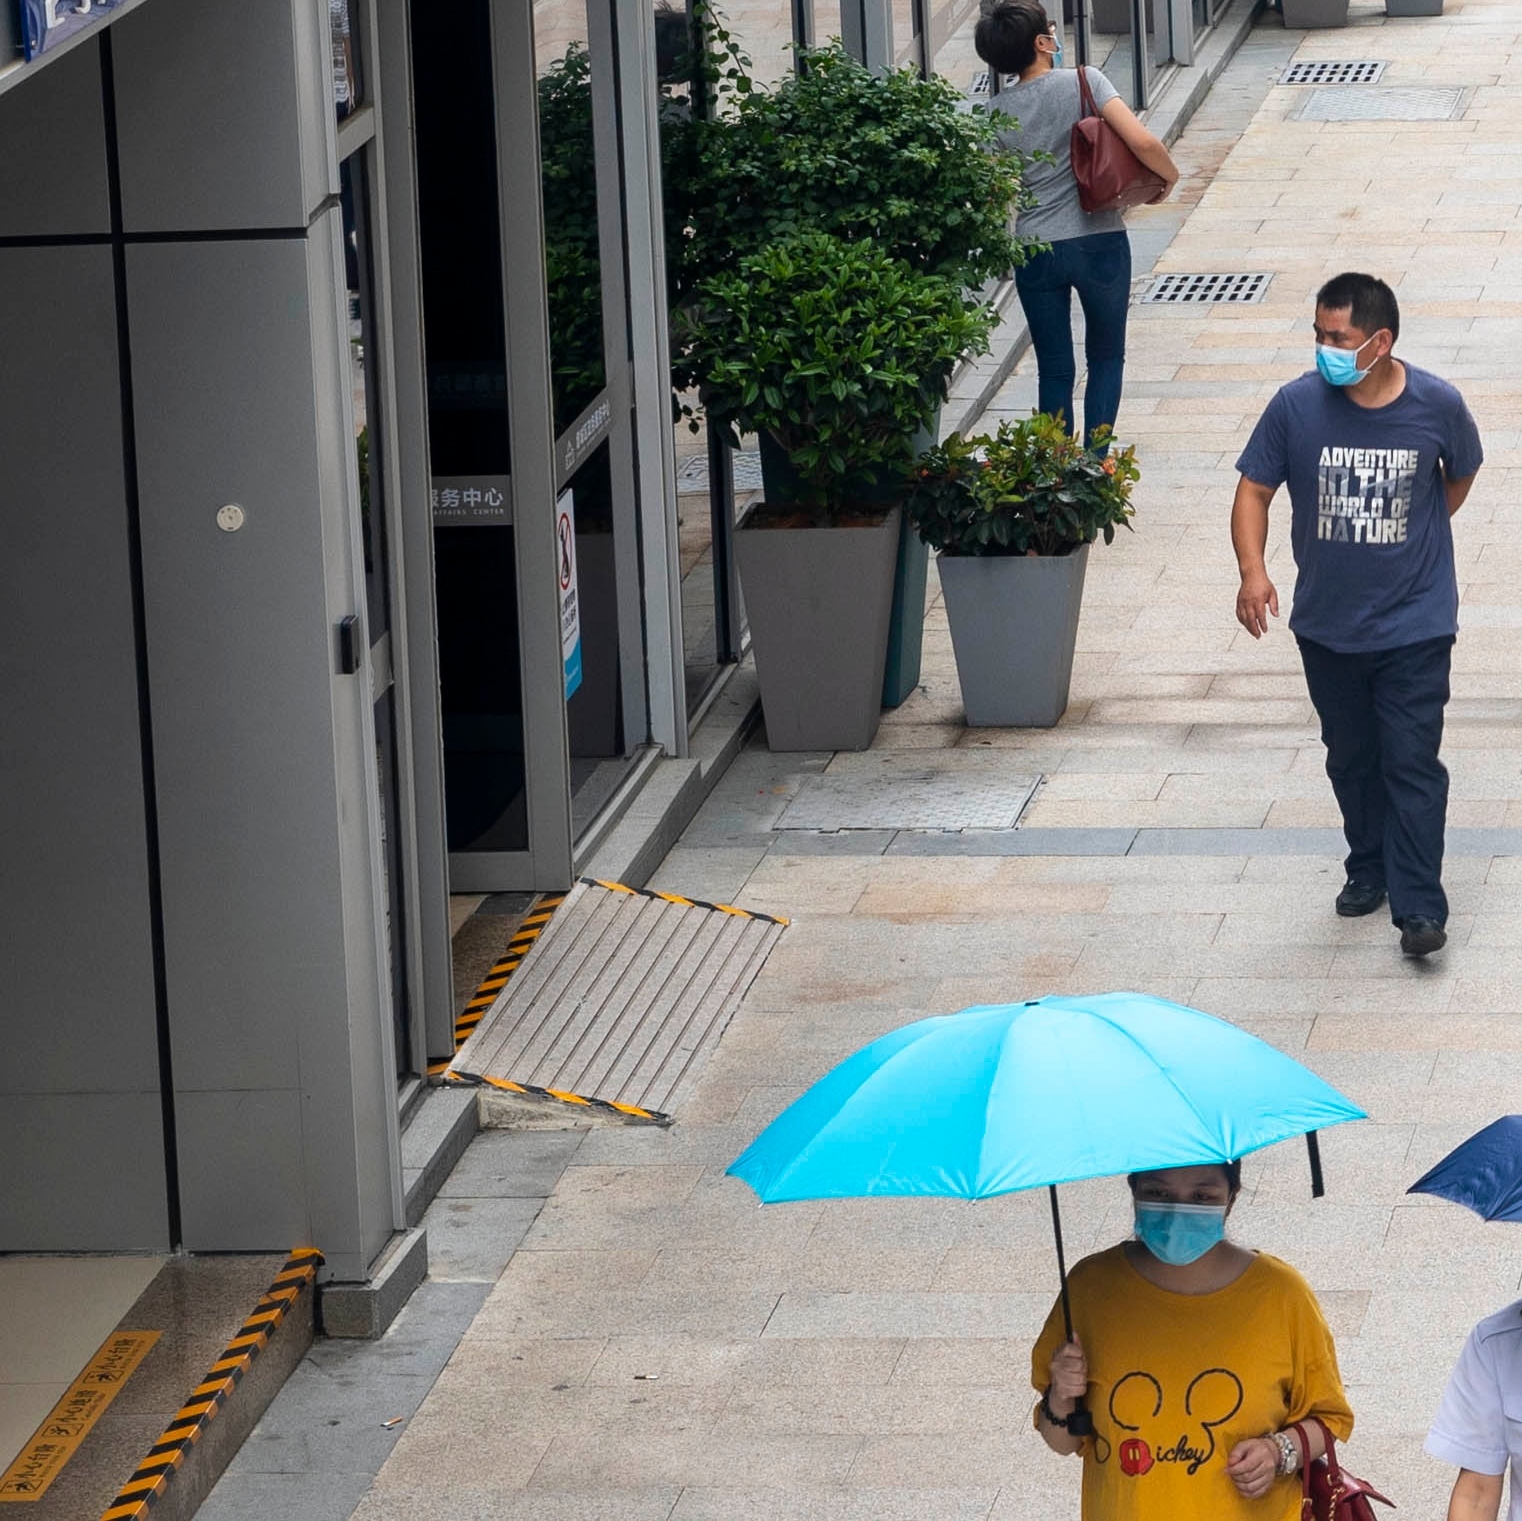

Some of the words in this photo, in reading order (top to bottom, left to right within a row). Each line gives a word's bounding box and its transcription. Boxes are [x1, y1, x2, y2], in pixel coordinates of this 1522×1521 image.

[1319, 446, 1419, 468] ADVENTURE
[1319, 467, 1349, 496] IN
[1355, 468, 1416, 498] THE
[1318, 495, 1384, 519] WORLD
[1391, 497, 1411, 519] OF
[1318, 516, 1408, 544] NATURE
